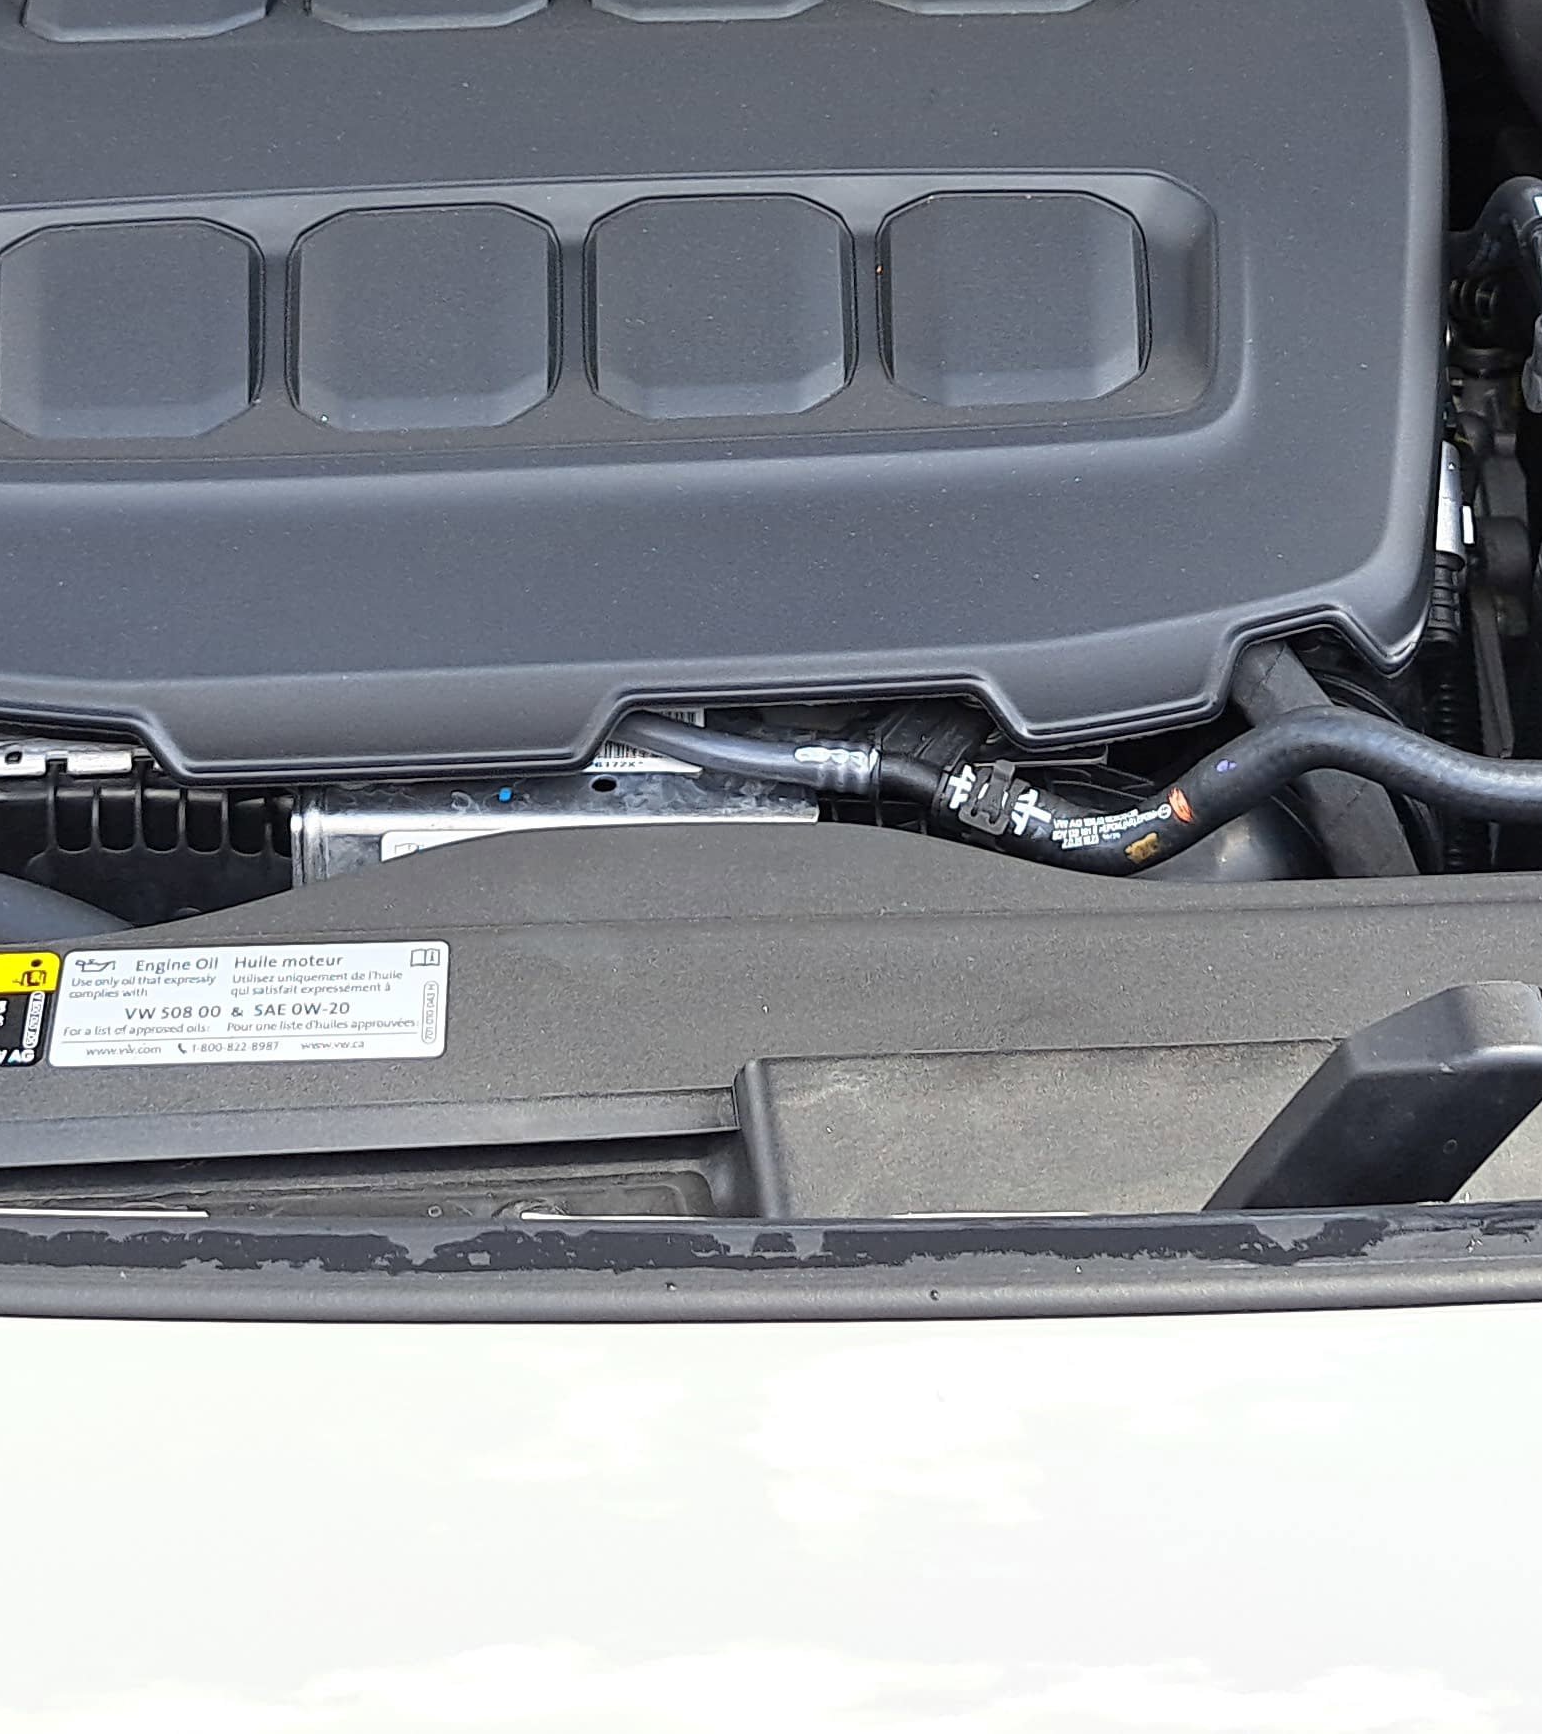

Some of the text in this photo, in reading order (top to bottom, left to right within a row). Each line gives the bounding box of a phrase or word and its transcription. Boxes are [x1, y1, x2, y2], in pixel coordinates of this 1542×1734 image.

[136, 955, 344, 974] Engine Oil Huile moteur
[71, 975, 217, 989] Use only oil that expressly
[233, 972, 275, 984] Utilisez
[277, 970, 348, 985] uniquement
[350, 970, 366, 981] de
[69, 987, 148, 1001] complies with
[230, 986, 249, 997] qui
[252, 984, 297, 995] satisfait
[300, 983, 379, 995] expressément
[125, 1001, 350, 1020] VW 508 00 & SAE 0W-20
[63, 1028, 82, 1037] For
[95, 1026, 111, 1035] list
[114, 1024, 127, 1035] of
[128, 1023, 184, 1037] approved
[227, 1021, 253, 1033] Pour
[279, 1020, 302, 1031] liste
[8, 1049, 35, 1064] AG
